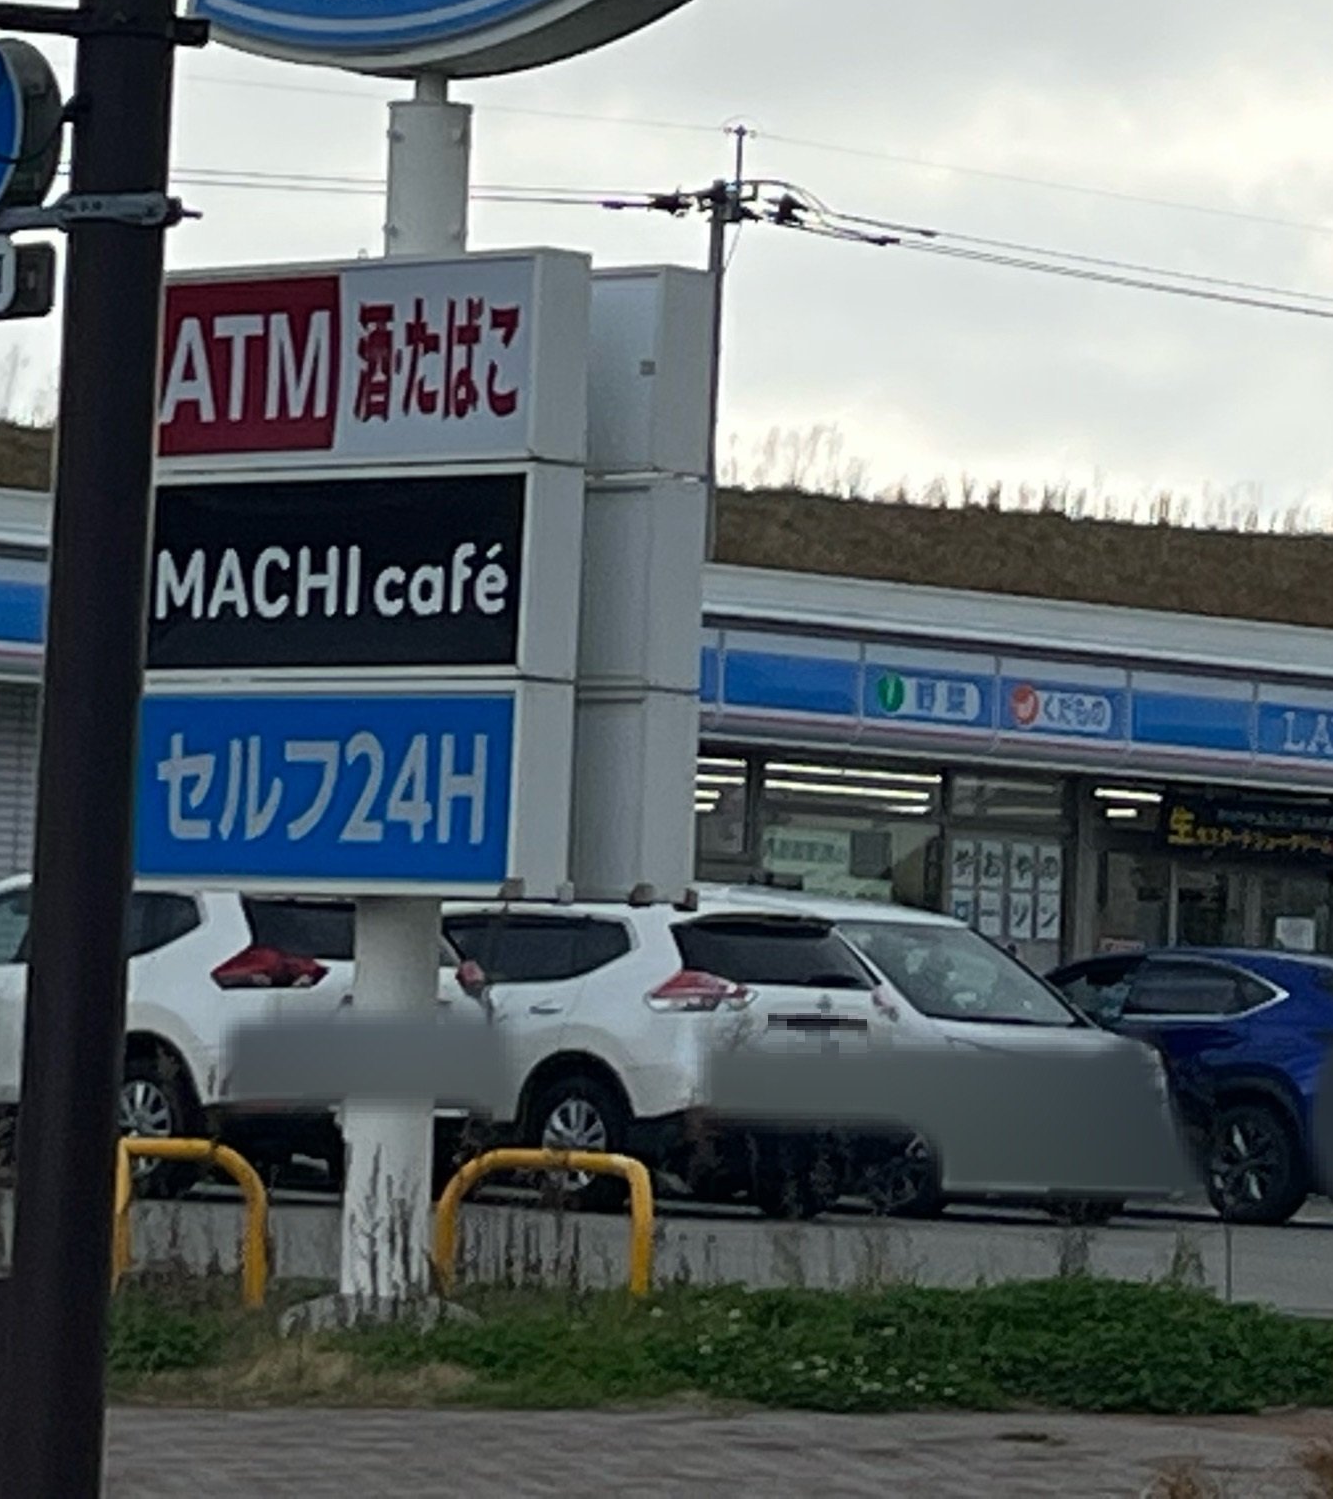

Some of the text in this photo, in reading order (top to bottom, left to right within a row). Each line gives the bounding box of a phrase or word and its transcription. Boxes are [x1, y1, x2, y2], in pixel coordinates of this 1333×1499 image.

[159, 309, 332, 424] ATM
[354, 297, 521, 423] 酒・たばこ
[154, 542, 509, 620] MACHI café
[1043, 692, 1107, 728] くだもの
[156, 731, 489, 845] セルフ24H
